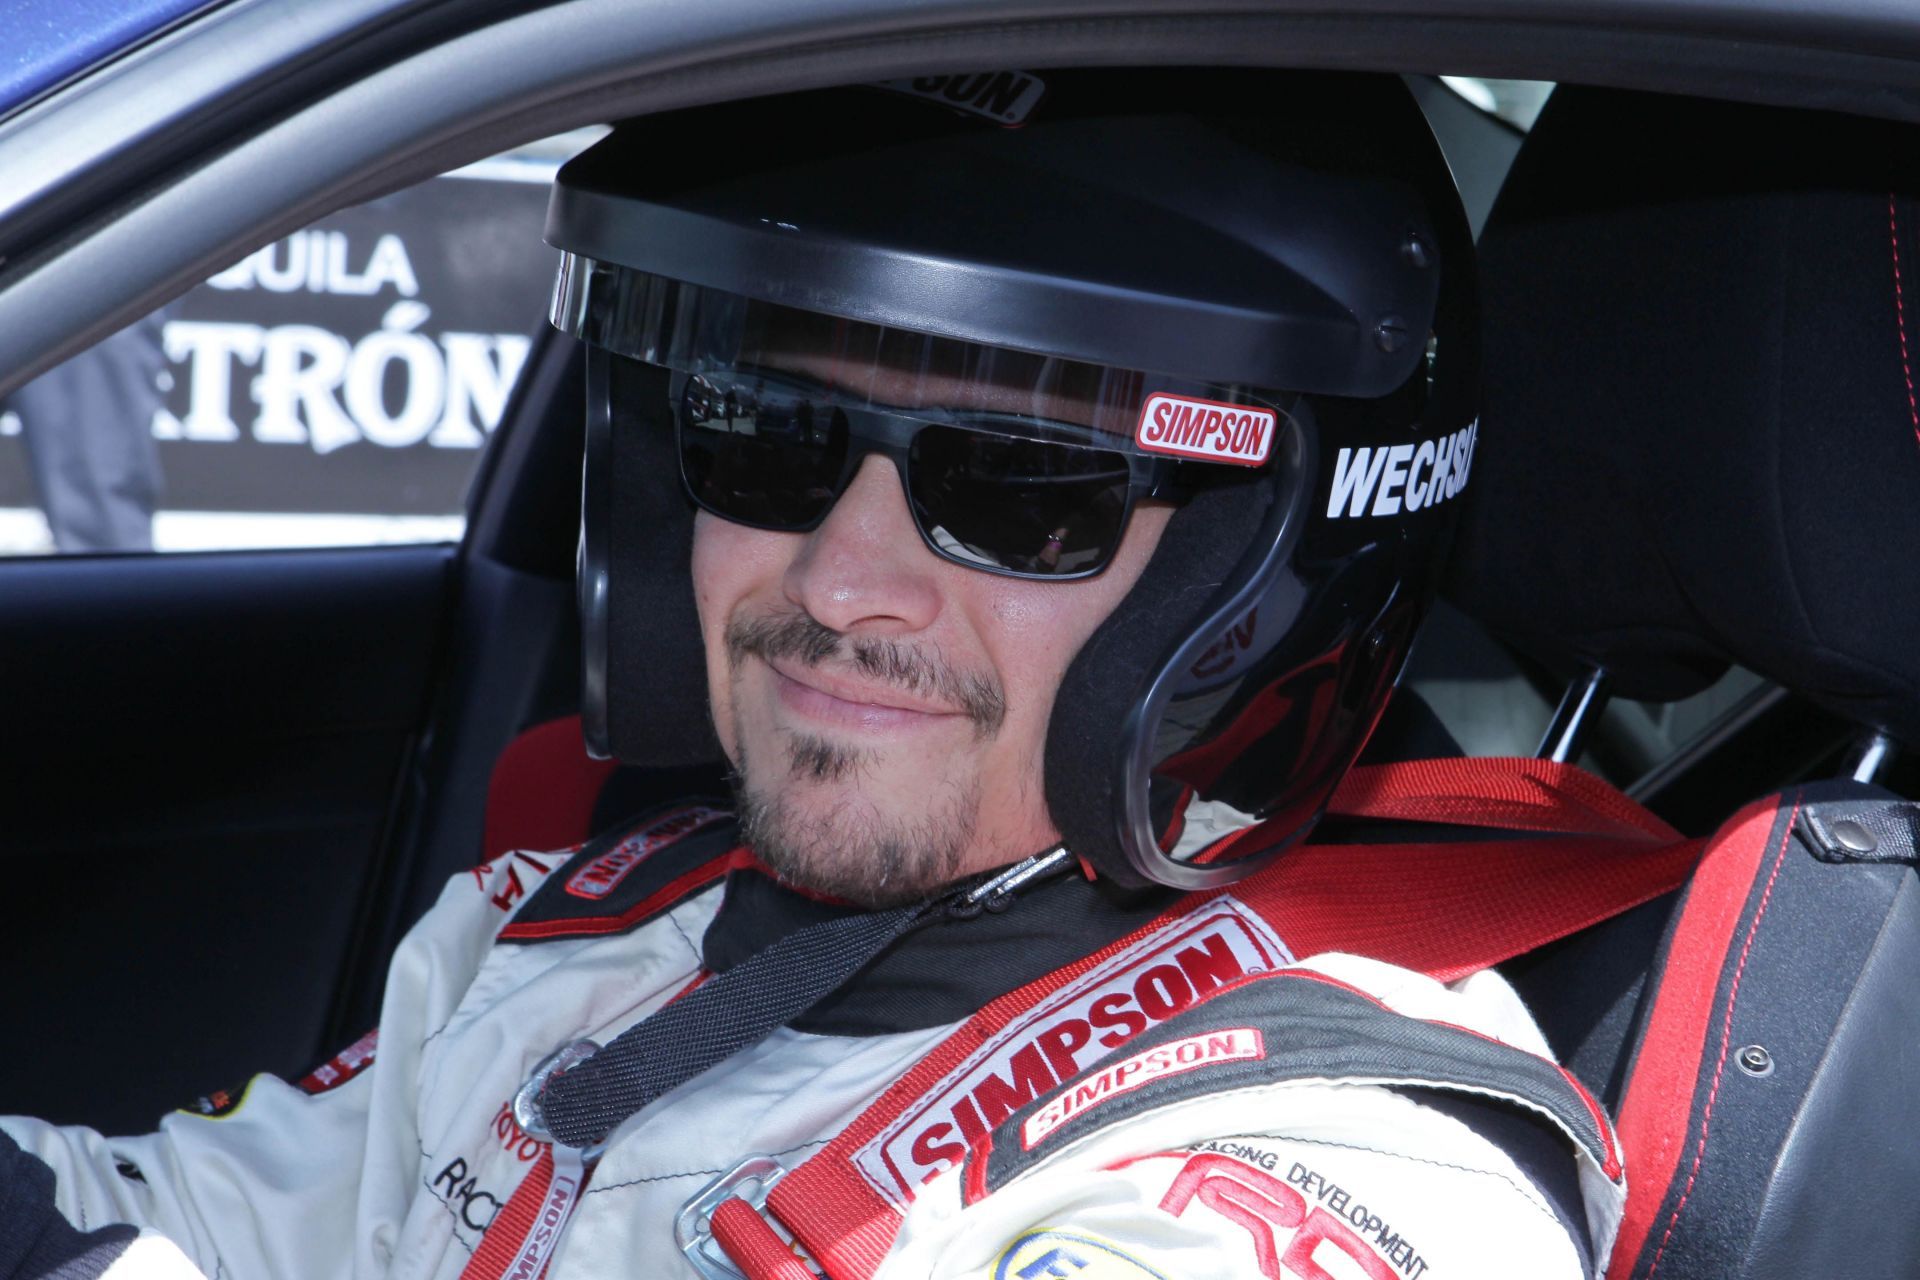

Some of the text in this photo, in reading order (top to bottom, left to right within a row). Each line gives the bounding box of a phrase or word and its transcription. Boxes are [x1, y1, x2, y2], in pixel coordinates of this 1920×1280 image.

[1146, 402, 1268, 456] SIMPSON
[911, 933, 1241, 1185] SIMPSON
[1037, 1034, 1237, 1133] SIMPSON
[1286, 1161, 1429, 1280] DEVELOPMENT
